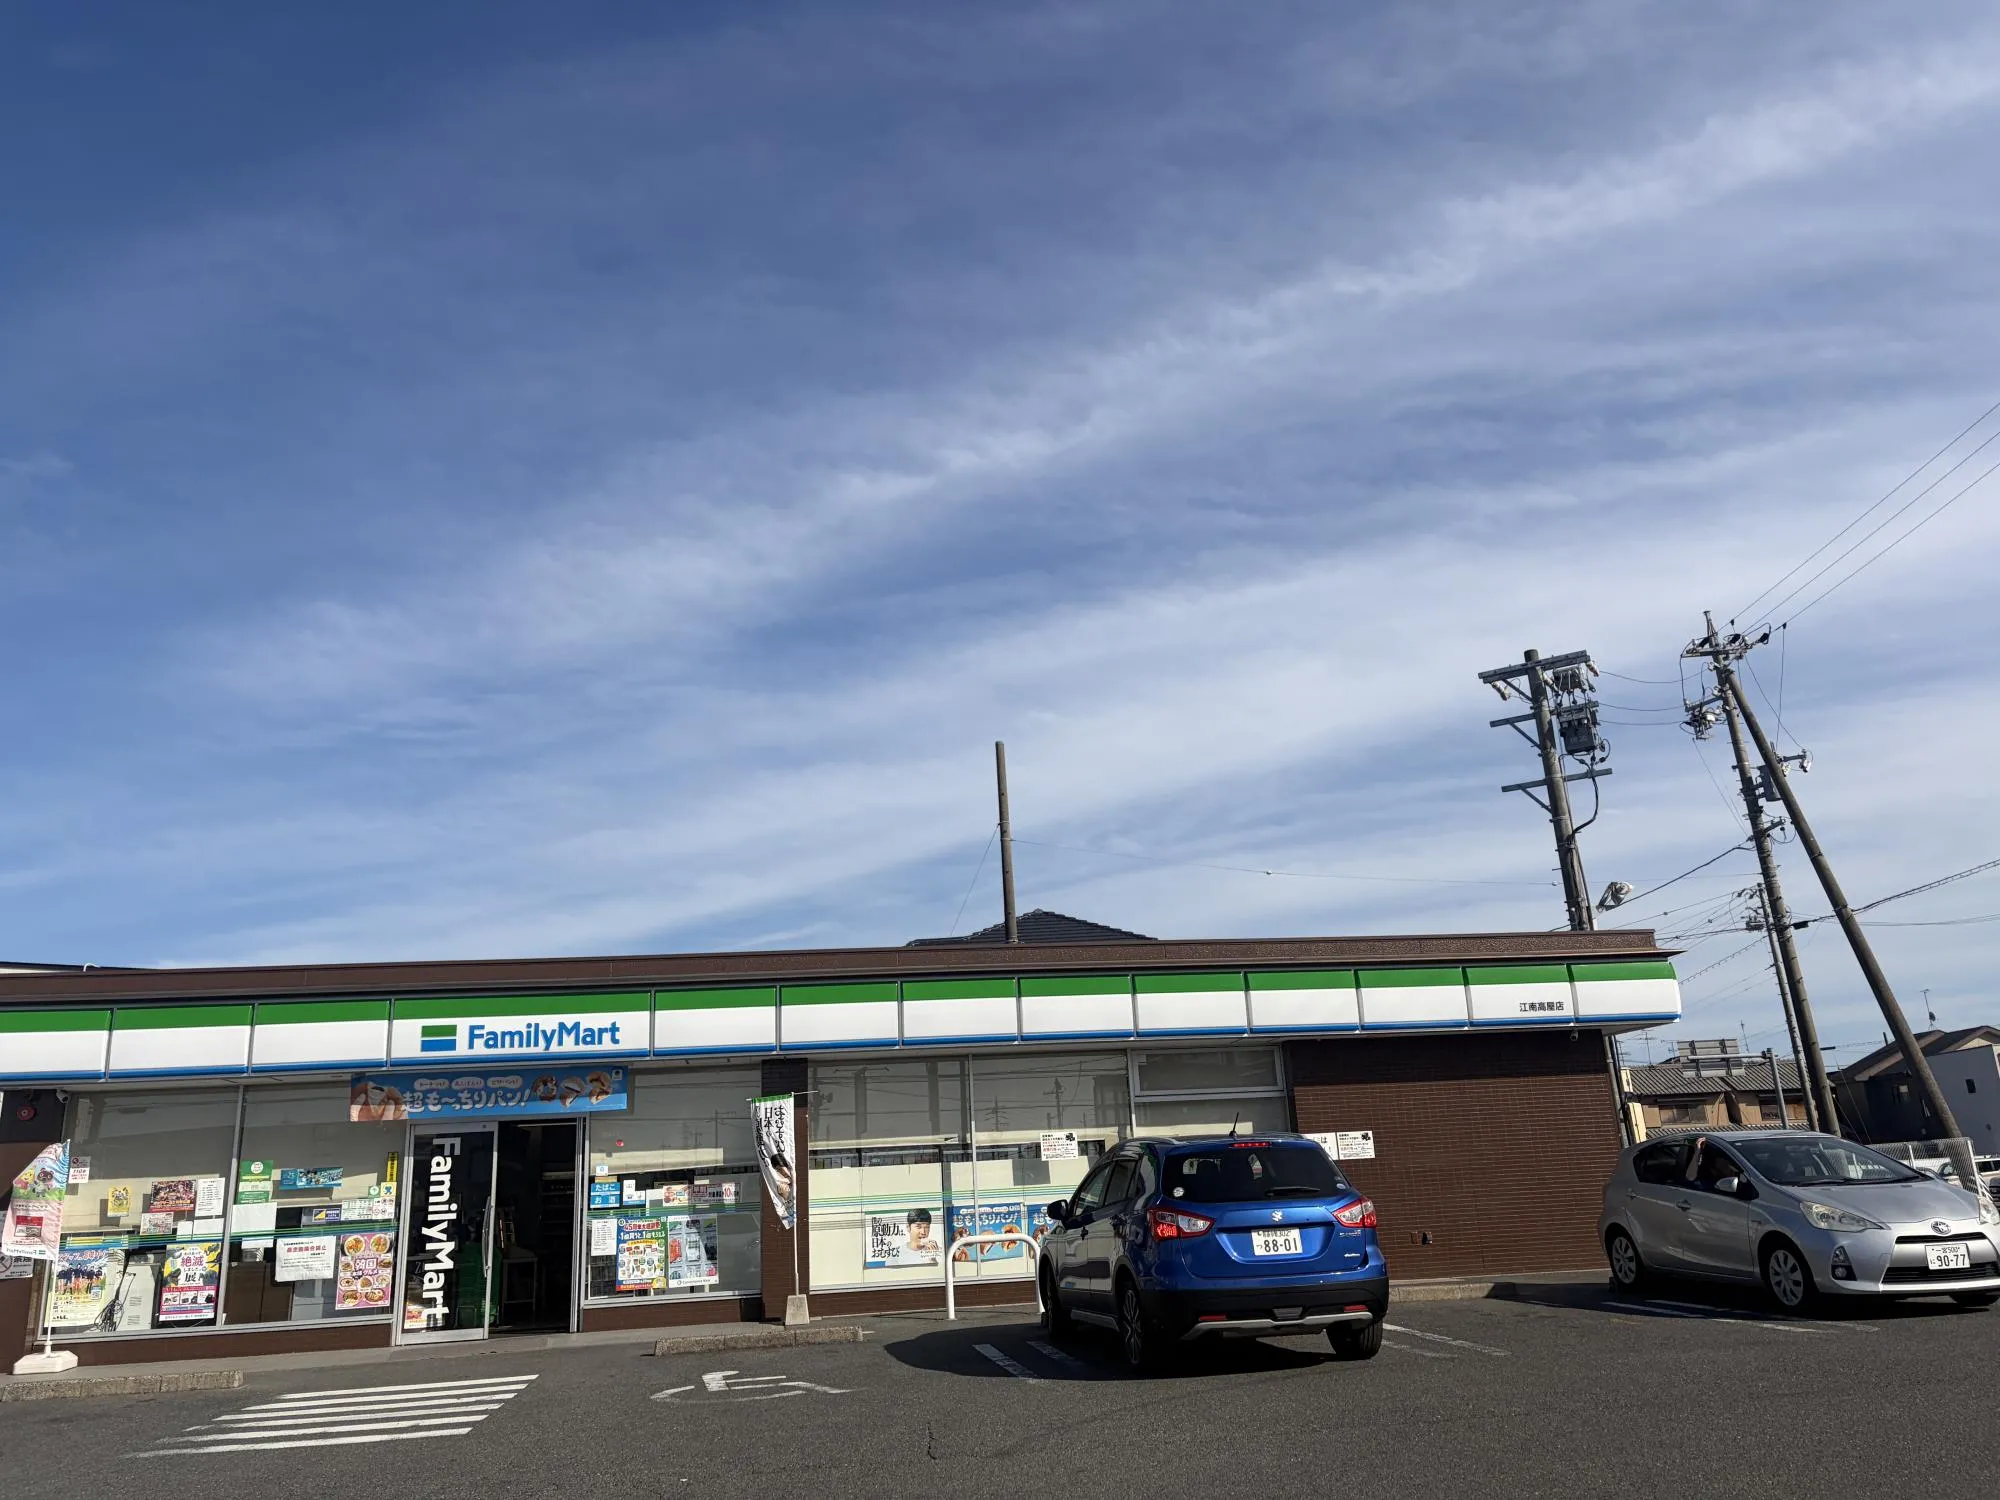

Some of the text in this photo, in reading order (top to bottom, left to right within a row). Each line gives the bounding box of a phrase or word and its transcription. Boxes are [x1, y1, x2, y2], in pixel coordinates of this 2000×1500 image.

[1519, 1001, 1565, 1012] 江南高屋店
[467, 1020, 621, 1051] FamilyMart
[421, 1137, 462, 1328] FamilyMart
[872, 1236, 892, 1247] 日本の
[1263, 1237, 1298, 1253] 88-01
[872, 1246, 900, 1259] おむすび
[181, 1256, 204, 1267] 絶滅
[1936, 1254, 1966, 1267] 90-77
